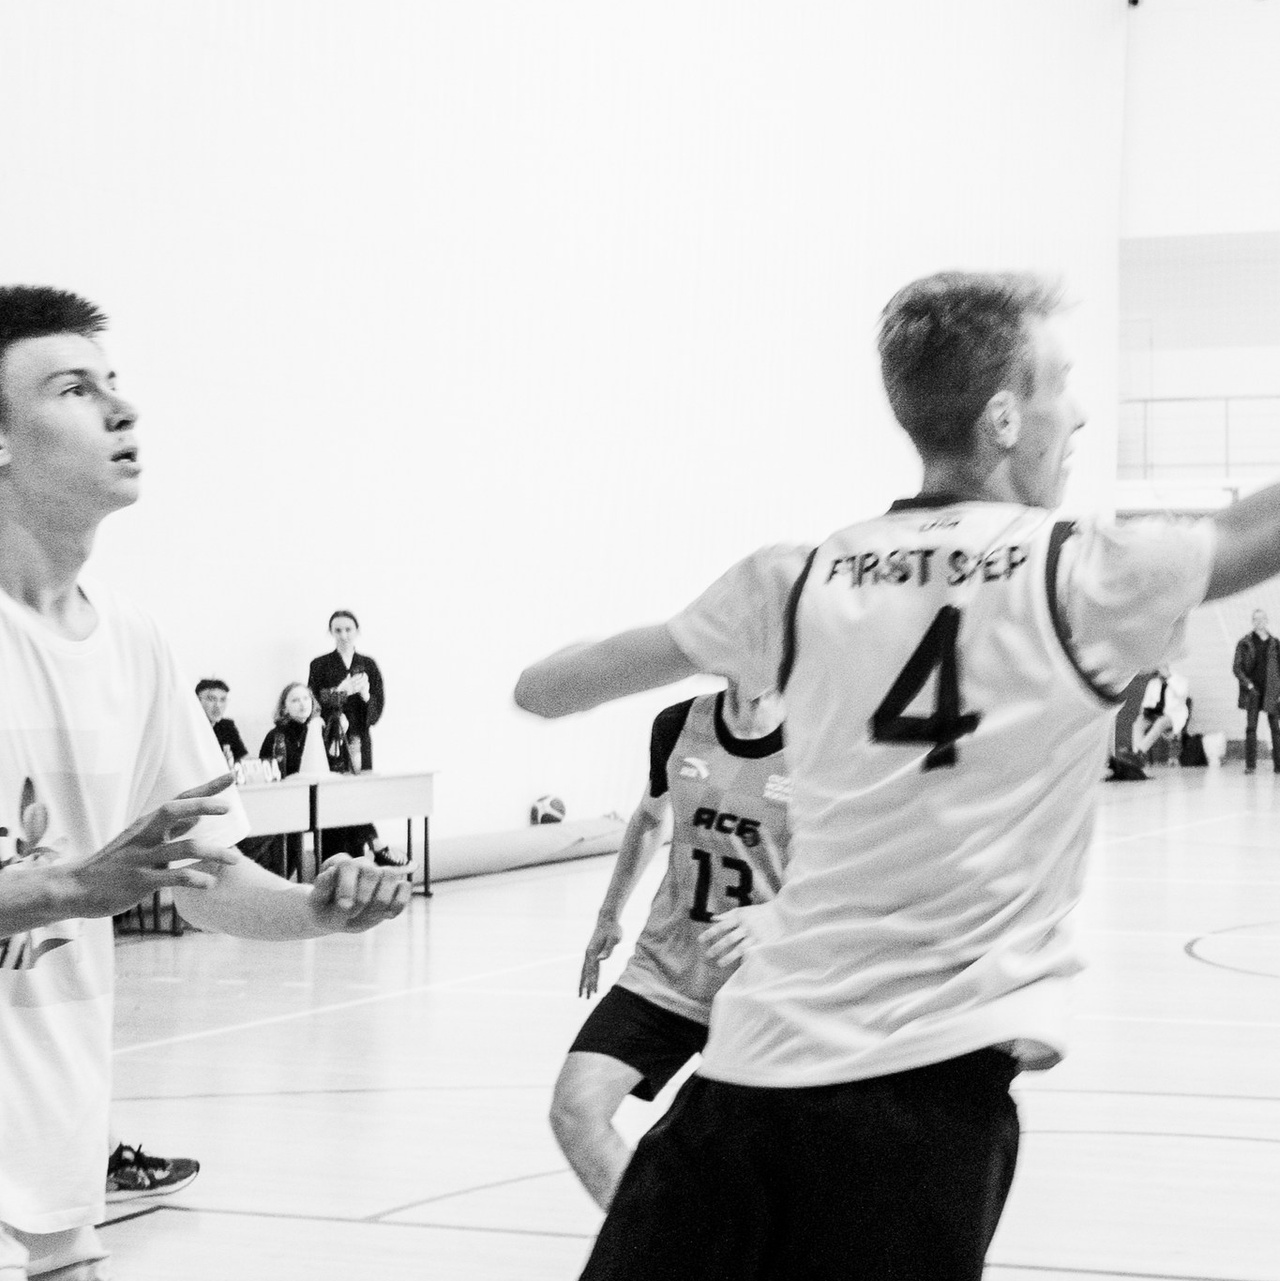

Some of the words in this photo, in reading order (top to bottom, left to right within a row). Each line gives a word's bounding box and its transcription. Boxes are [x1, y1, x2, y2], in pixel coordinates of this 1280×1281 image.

[825, 548, 937, 587] FIRST
[870, 604, 982, 772] 4
[689, 848, 753, 926] 13
